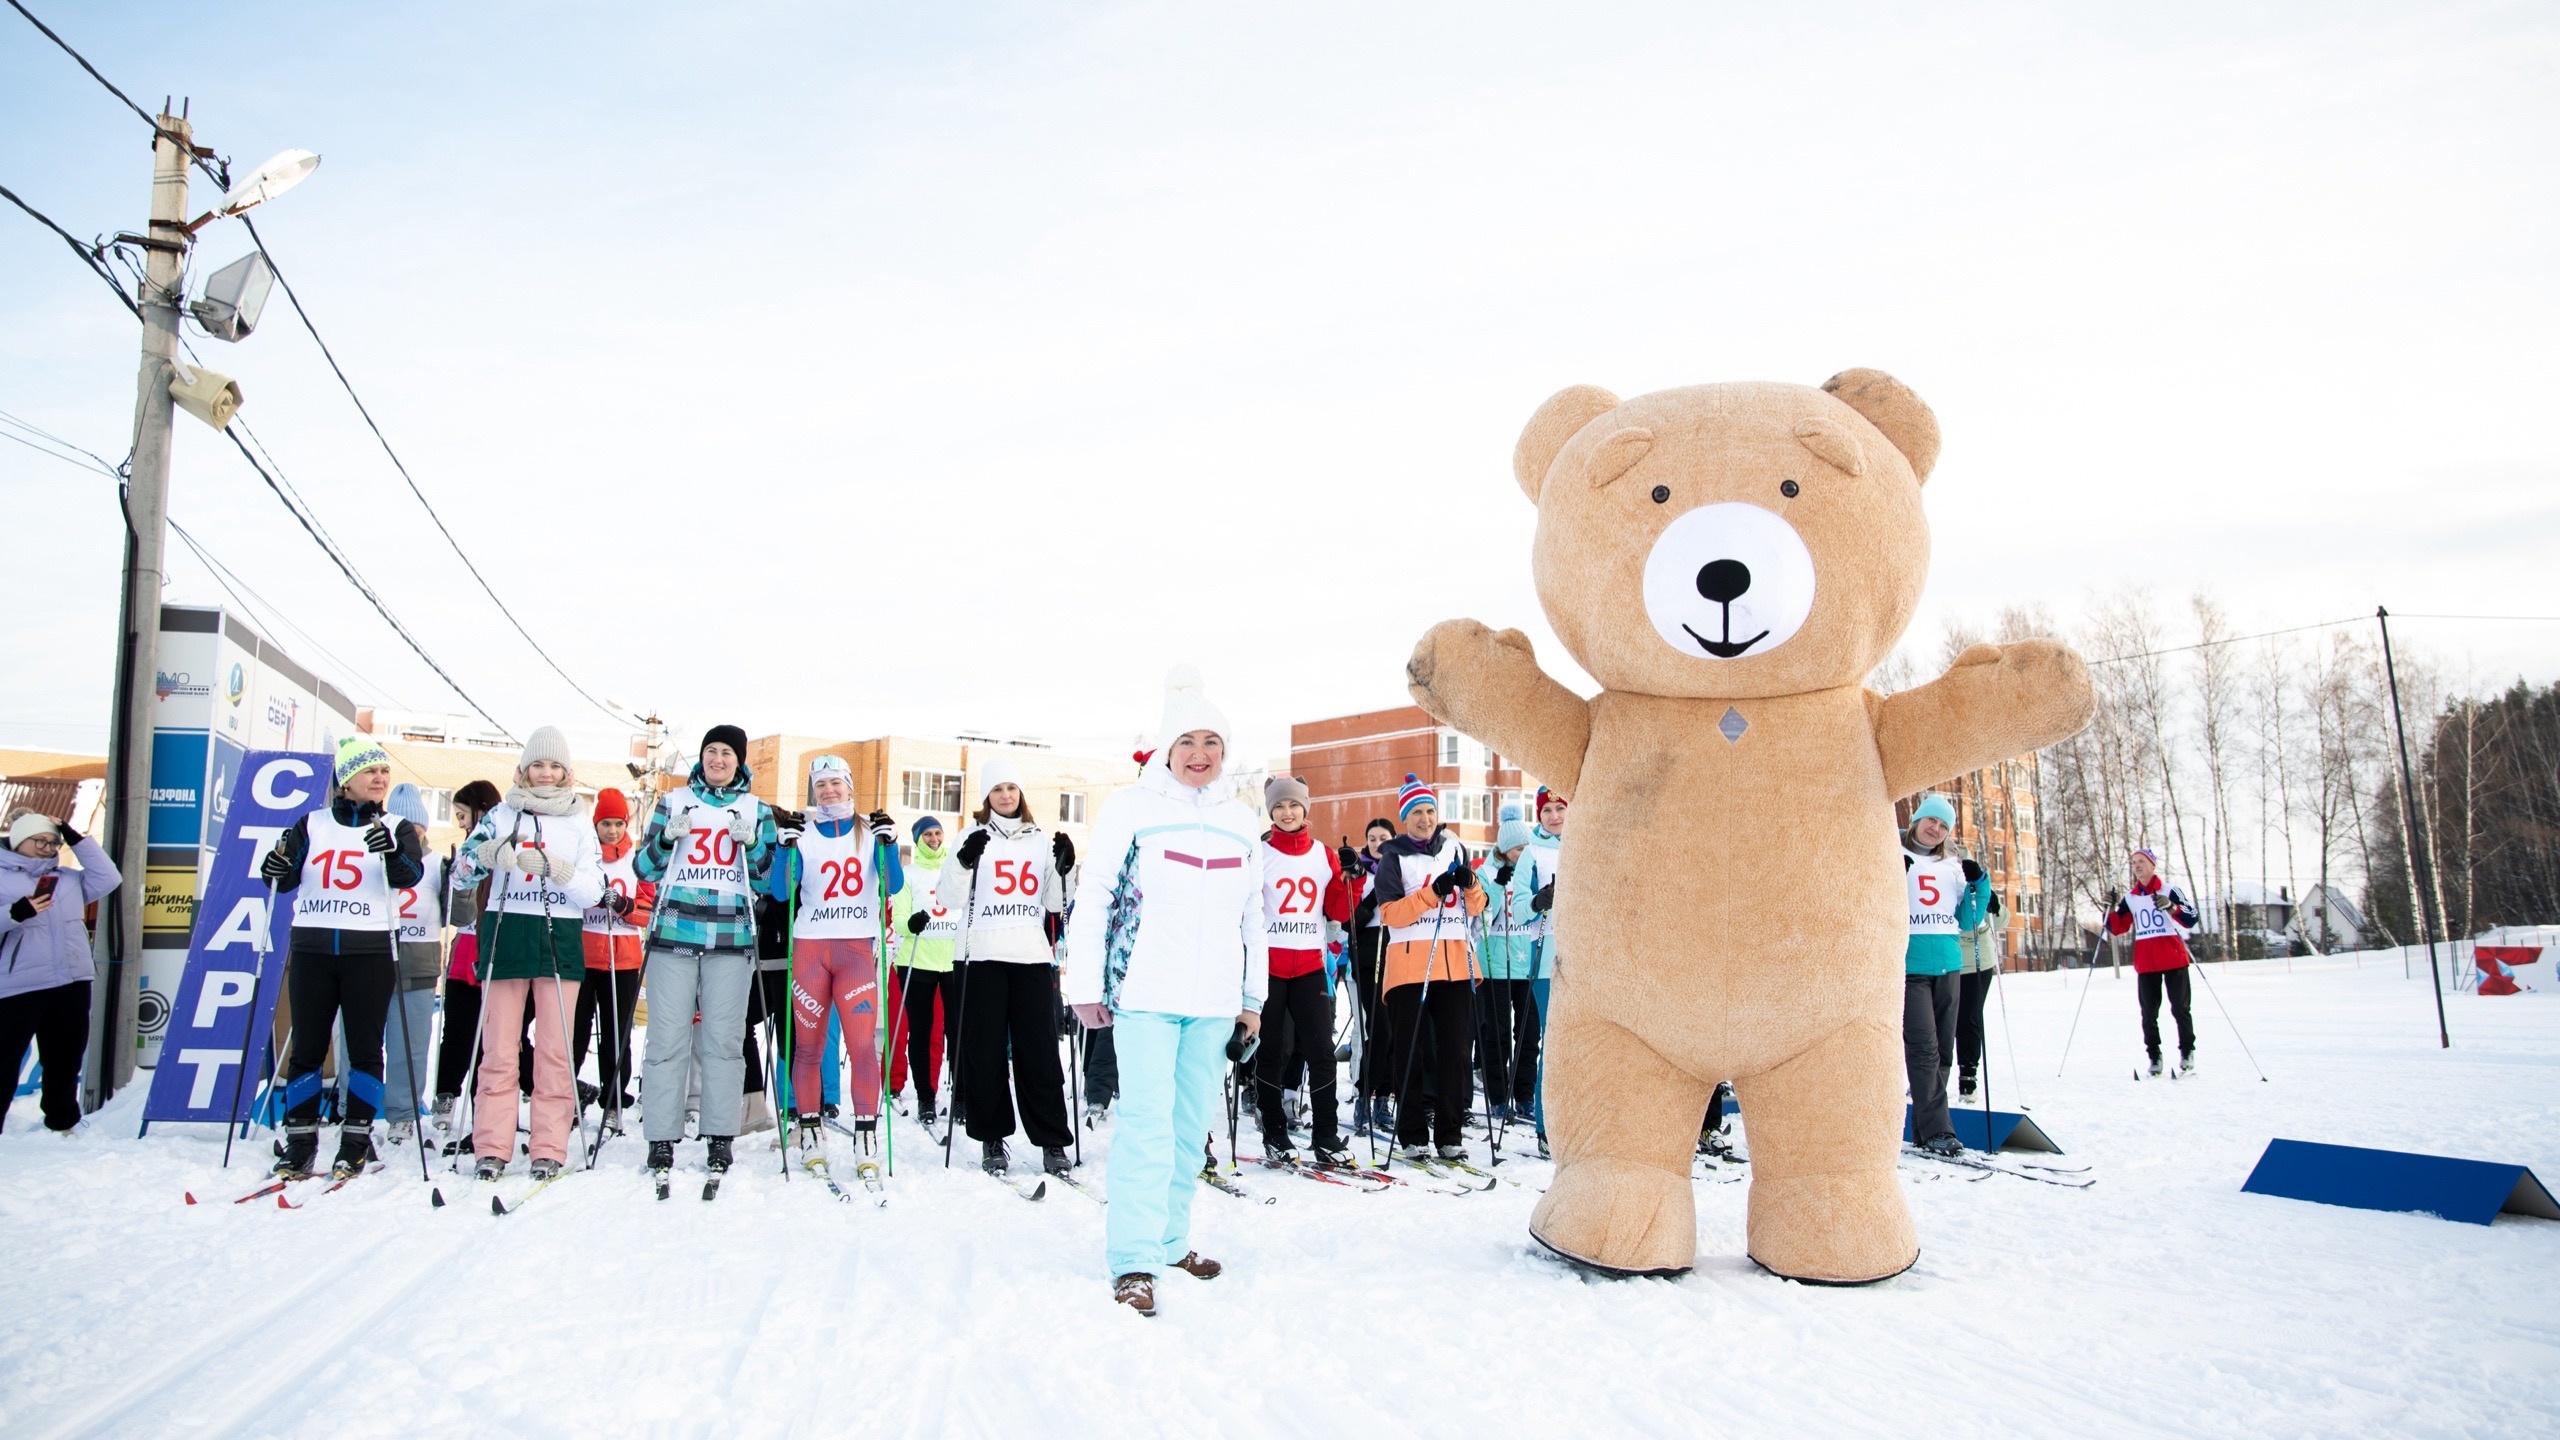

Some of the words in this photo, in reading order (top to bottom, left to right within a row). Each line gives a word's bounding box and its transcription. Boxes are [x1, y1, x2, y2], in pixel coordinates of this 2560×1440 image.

[687, 827, 738, 866] 30
[311, 849, 364, 891] 15
[676, 868, 742, 883] ДМИТРОВ
[821, 857, 863, 901] 28
[993, 860, 1039, 896] 56
[145, 894, 193, 906] ДКИНА
[1275, 877, 1318, 914] 29
[1918, 875, 1940, 907] 5
[300, 899, 370, 916] ДМИТРОВ
[810, 906, 868, 922] ДМИТРОВ
[1909, 913, 1955, 925] МИТРОВ
[924, 921, 958, 931] МИТРО
[791, 980, 825, 1018] LUKOIL
[844, 981, 877, 1001] SCANIA
